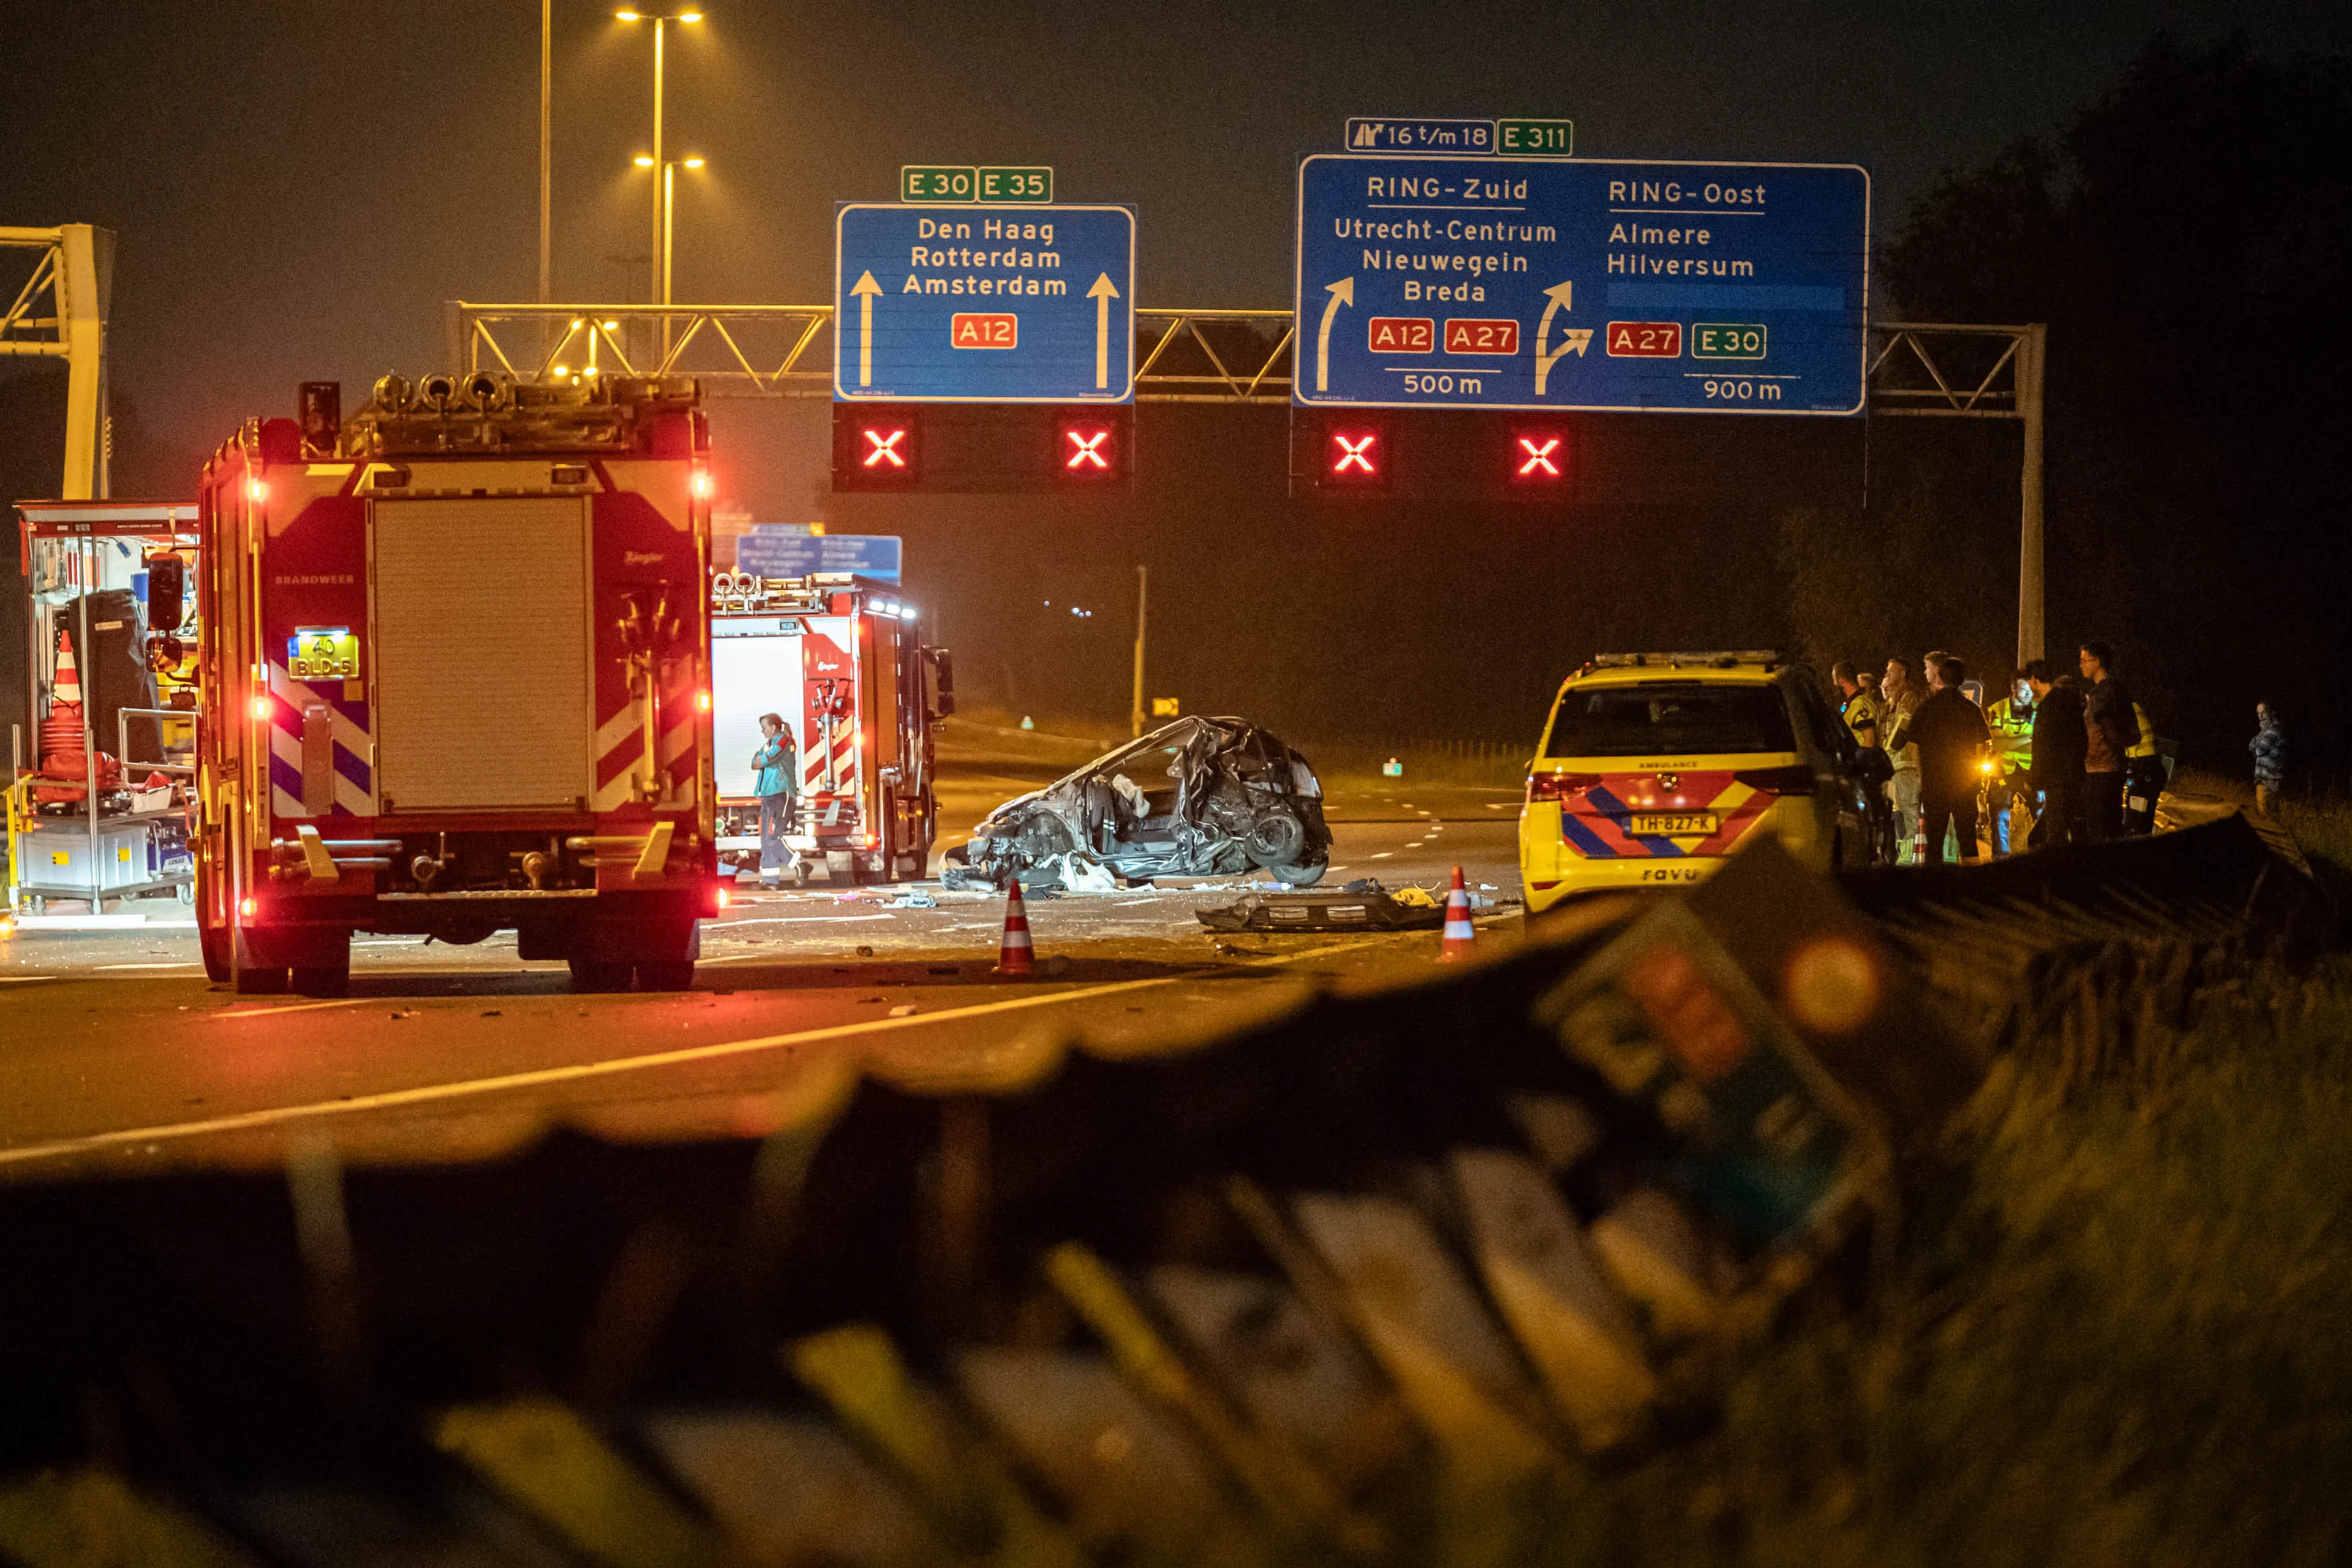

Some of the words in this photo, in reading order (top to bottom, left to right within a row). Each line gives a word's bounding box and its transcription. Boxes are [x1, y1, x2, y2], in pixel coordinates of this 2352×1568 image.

[1388, 126, 1412, 145] 16
[1418, 126, 1457, 145] t/m
[1463, 127, 1487, 146] 18
[1504, 127, 1520, 148] E
[1528, 127, 1564, 148] 311
[909, 173, 925, 194] E
[933, 174, 969, 195] 30
[984, 174, 1001, 195] E
[1009, 175, 1044, 195] 35
[1368, 176, 1527, 200] RING-Zuid
[1609, 181, 1766, 204] RING-Oost
[919, 218, 970, 239] Den
[984, 219, 1054, 246] Haag
[1335, 217, 1556, 242] Utrecht-Centrum
[1608, 223, 1711, 245] Almere
[911, 246, 1060, 268] Rotterdam
[1363, 249, 1527, 277] Nieuwegein
[1607, 253, 1754, 276] Hilversum
[902, 274, 1066, 295] Amsterdam
[1404, 281, 1485, 302] Breda
[959, 321, 1011, 342] A12
[1376, 325, 1427, 345] A12
[1452, 326, 1512, 347] A27
[1614, 329, 1674, 350] A27
[1702, 330, 1717, 351] E
[1724, 331, 1760, 352] 30
[1404, 375, 1453, 394] 500
[1460, 378, 1482, 394] m
[1704, 380, 1752, 399] 900
[1759, 384, 1781, 400] m
[276, 575, 354, 584] BRANDWEER
[312, 637, 335, 655] 40
[297, 657, 352, 675] BLD-5
[1637, 816, 1709, 831] TH-827-K
[1643, 869, 1698, 881] ravu
